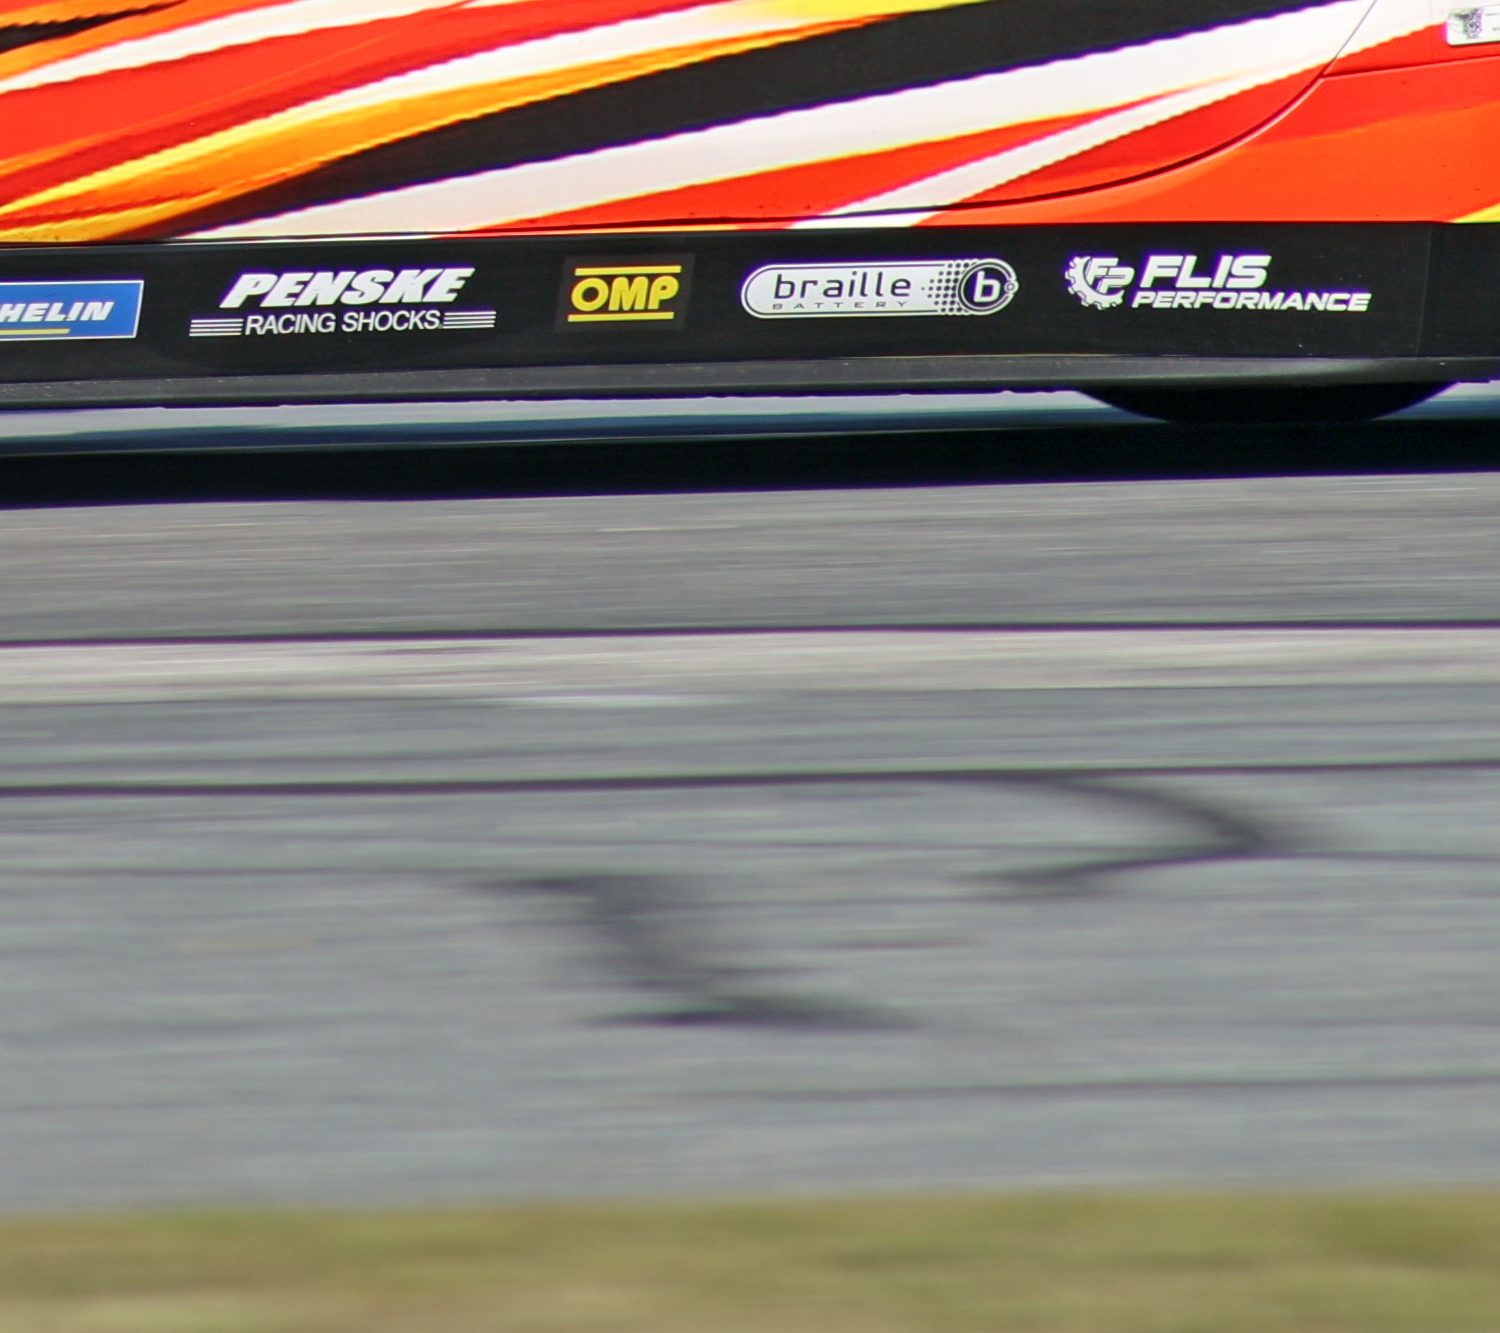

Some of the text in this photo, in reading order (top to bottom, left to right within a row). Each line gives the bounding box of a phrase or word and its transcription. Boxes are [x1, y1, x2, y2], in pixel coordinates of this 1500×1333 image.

[773, 270, 912, 300] braille
[1139, 254, 1272, 289] FLIS
[220, 267, 475, 308] PENSKE
[570, 276, 680, 313] OMP
[1131, 290, 1373, 313] PERFORMANCE
[771, 300, 908, 311] BATTERY
[244, 308, 442, 337] RACING SHOCKS
